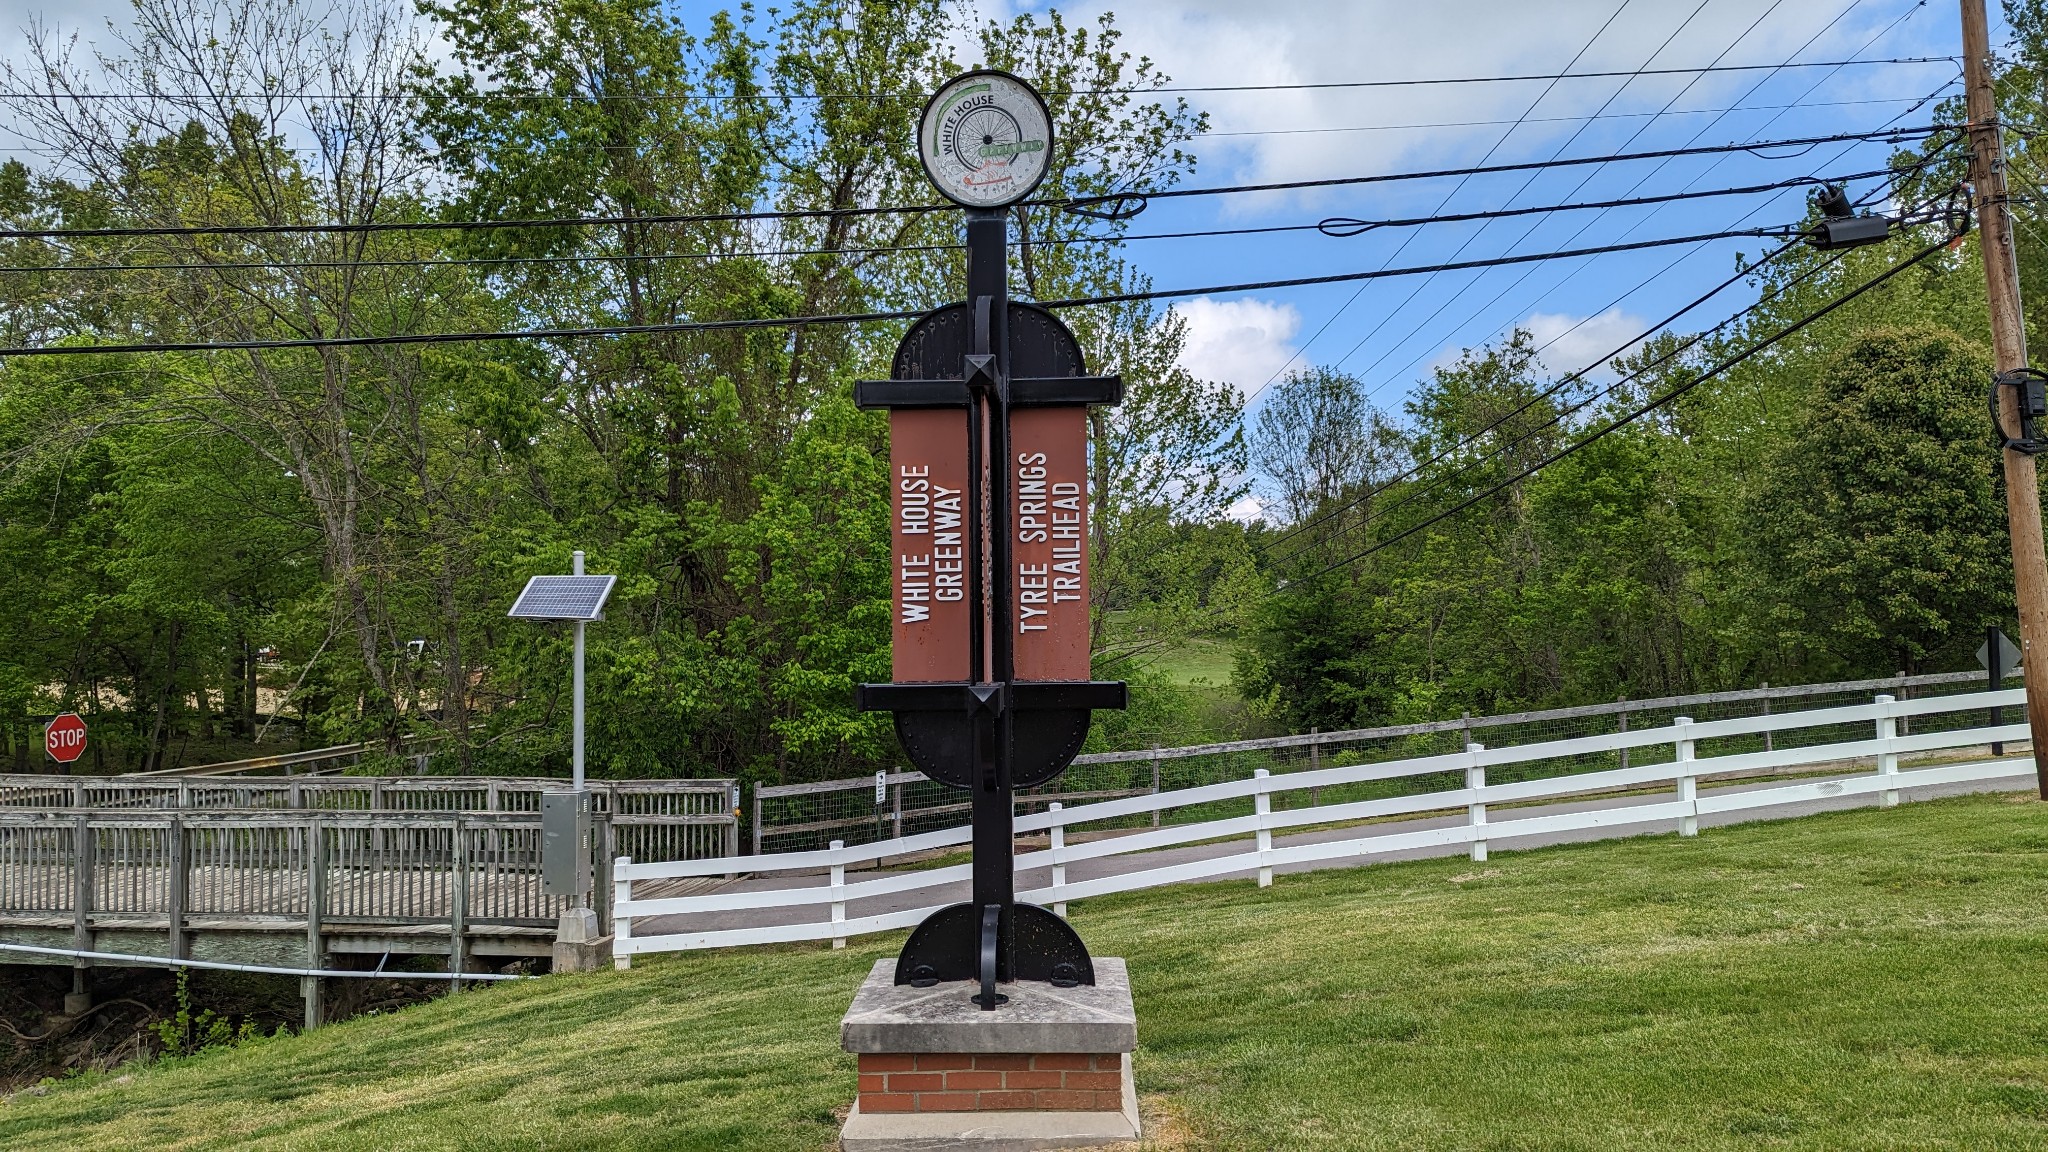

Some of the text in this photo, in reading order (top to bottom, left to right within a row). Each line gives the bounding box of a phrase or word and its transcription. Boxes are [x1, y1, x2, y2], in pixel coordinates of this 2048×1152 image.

[942, 95, 994, 155] WHITE HOUSE
[901, 465, 930, 624] WHITE HOUSE
[933, 484, 963, 602] GREENWAY
[1018, 452, 1048, 634] TYREE SPRINGS
[1051, 482, 1081, 604] TRAILHEAD
[49, 728, 85, 749] STOP
